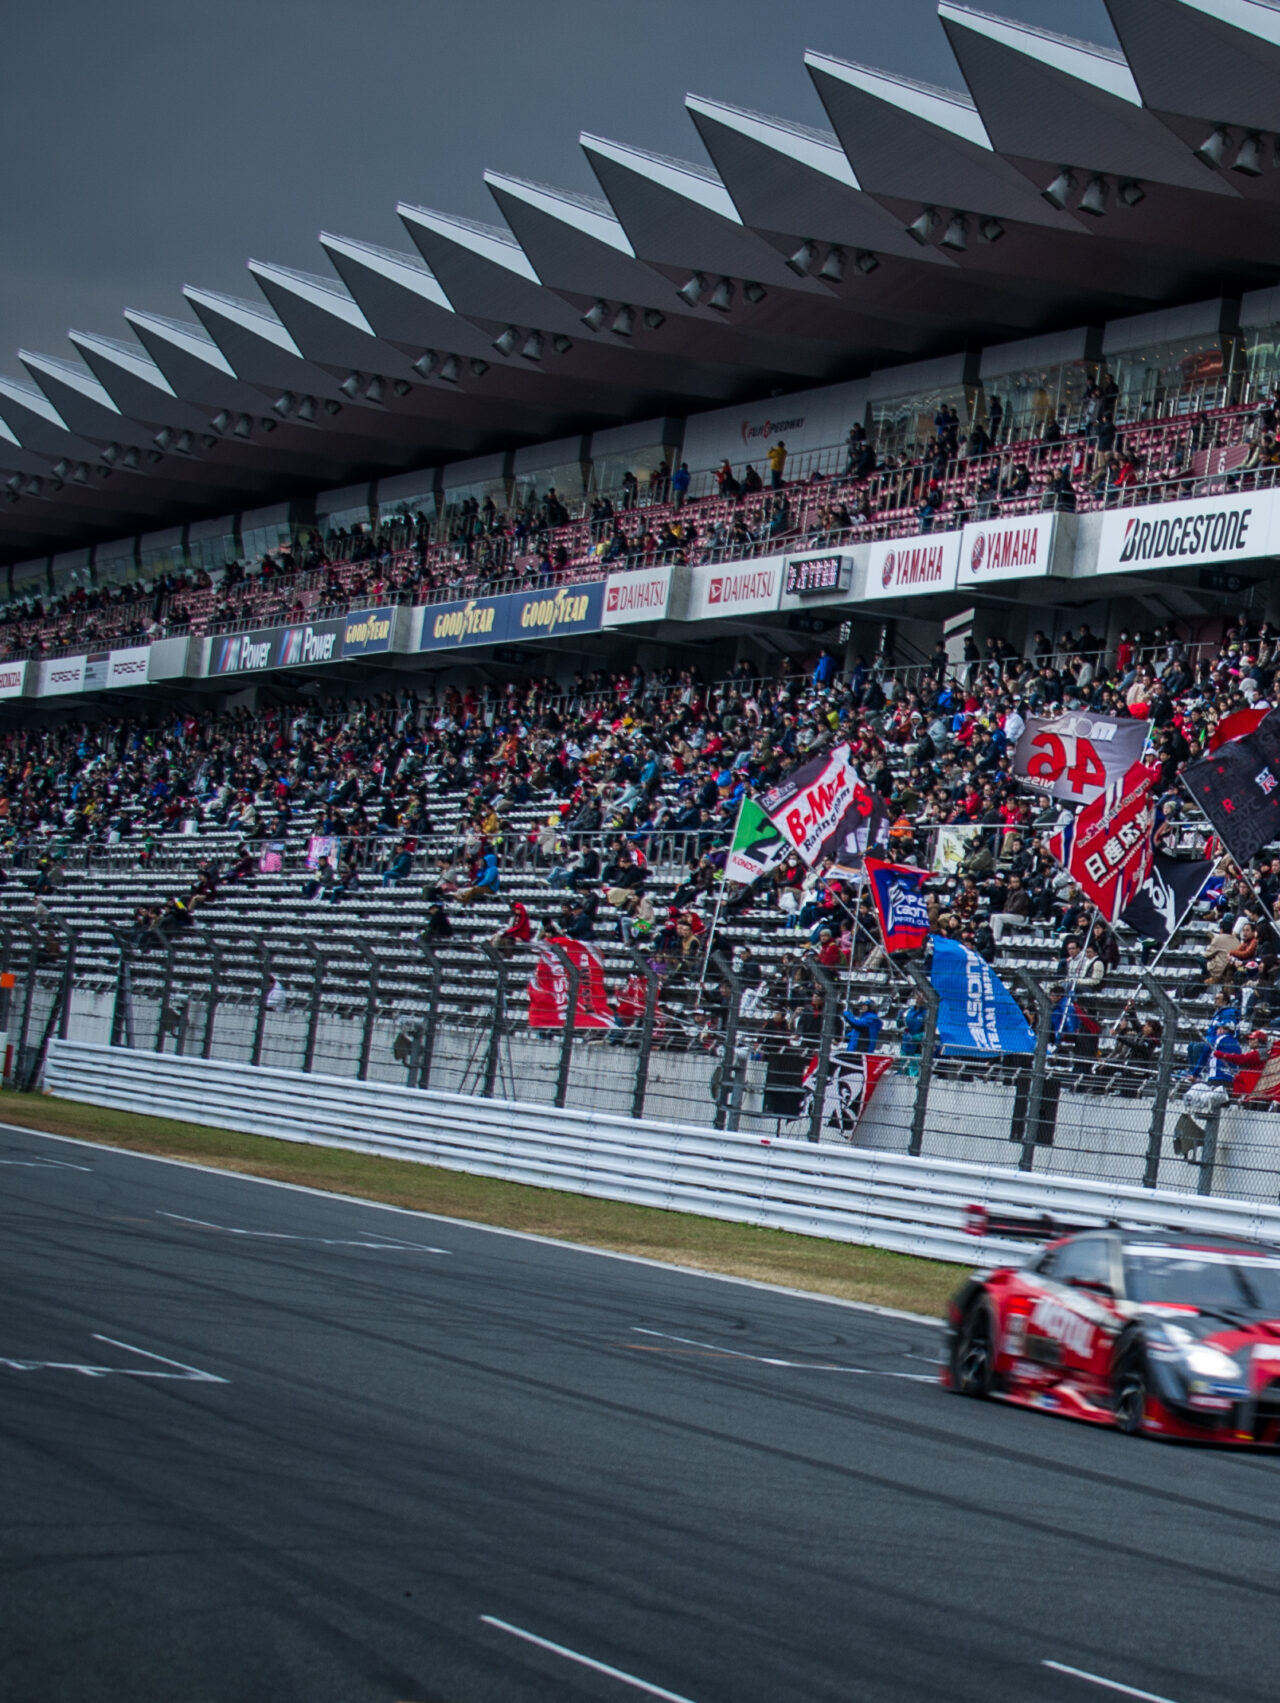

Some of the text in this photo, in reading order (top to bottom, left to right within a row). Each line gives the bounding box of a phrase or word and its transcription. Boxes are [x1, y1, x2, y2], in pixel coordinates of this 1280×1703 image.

[987, 526, 1039, 570] YAMAHA
[1119, 508, 1252, 563] BRIDGESTONE
[896, 545, 944, 586] YAMAHA
[620, 580, 667, 611] DAIHATSU
[723, 571, 774, 602] DAIHATSU
[433, 601, 495, 643] GOODYEAR
[521, 589, 589, 634] GOODYEAR
[303, 627, 336, 662] Power
[345, 615, 389, 647] GOODYEAR
[240, 635, 271, 669] Power
